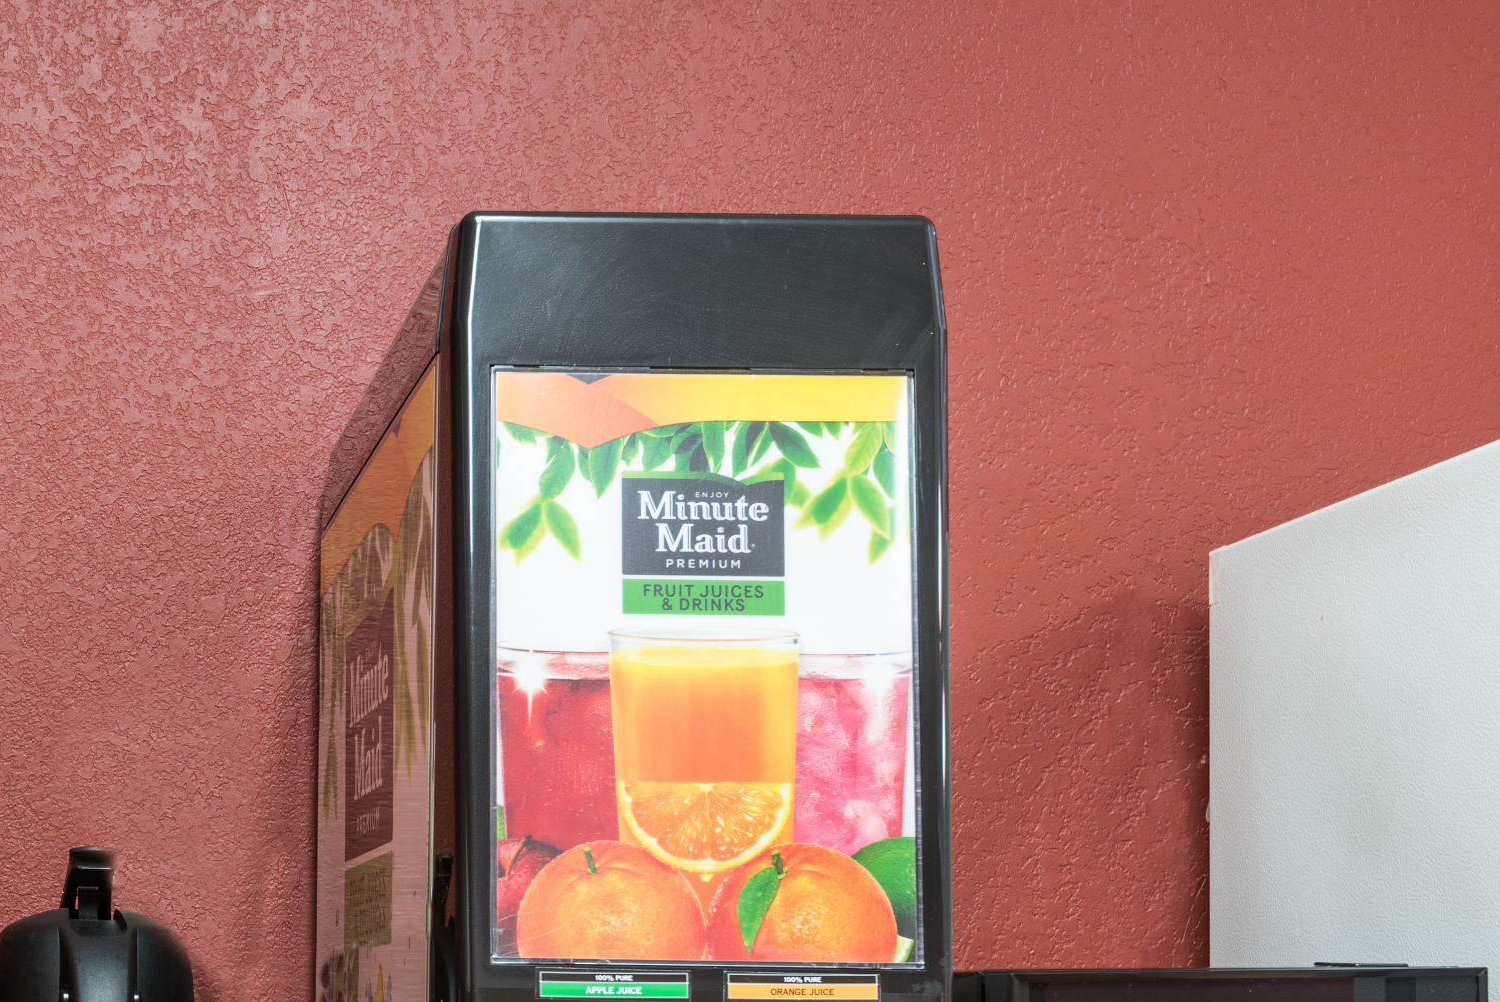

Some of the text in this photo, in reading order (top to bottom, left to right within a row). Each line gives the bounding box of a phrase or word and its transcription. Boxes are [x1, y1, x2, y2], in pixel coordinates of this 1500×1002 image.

[695, 491, 728, 499] ENJOY
[637, 490, 769, 523] Minute
[655, 522, 752, 554] Maid
[666, 559, 741, 569] PREMIUM
[643, 584, 764, 600] FRUIT JUICES
[661, 598, 745, 612] & DRINKS
[349, 640, 389, 728] Minute
[353, 715, 383, 801] Maid
[595, 974, 633, 982] 100% PURE
[783, 976, 822, 984] 100% PURE
[585, 985, 643, 995] APPLE JUICE
[770, 987, 835, 997] ORANGE JUICE
